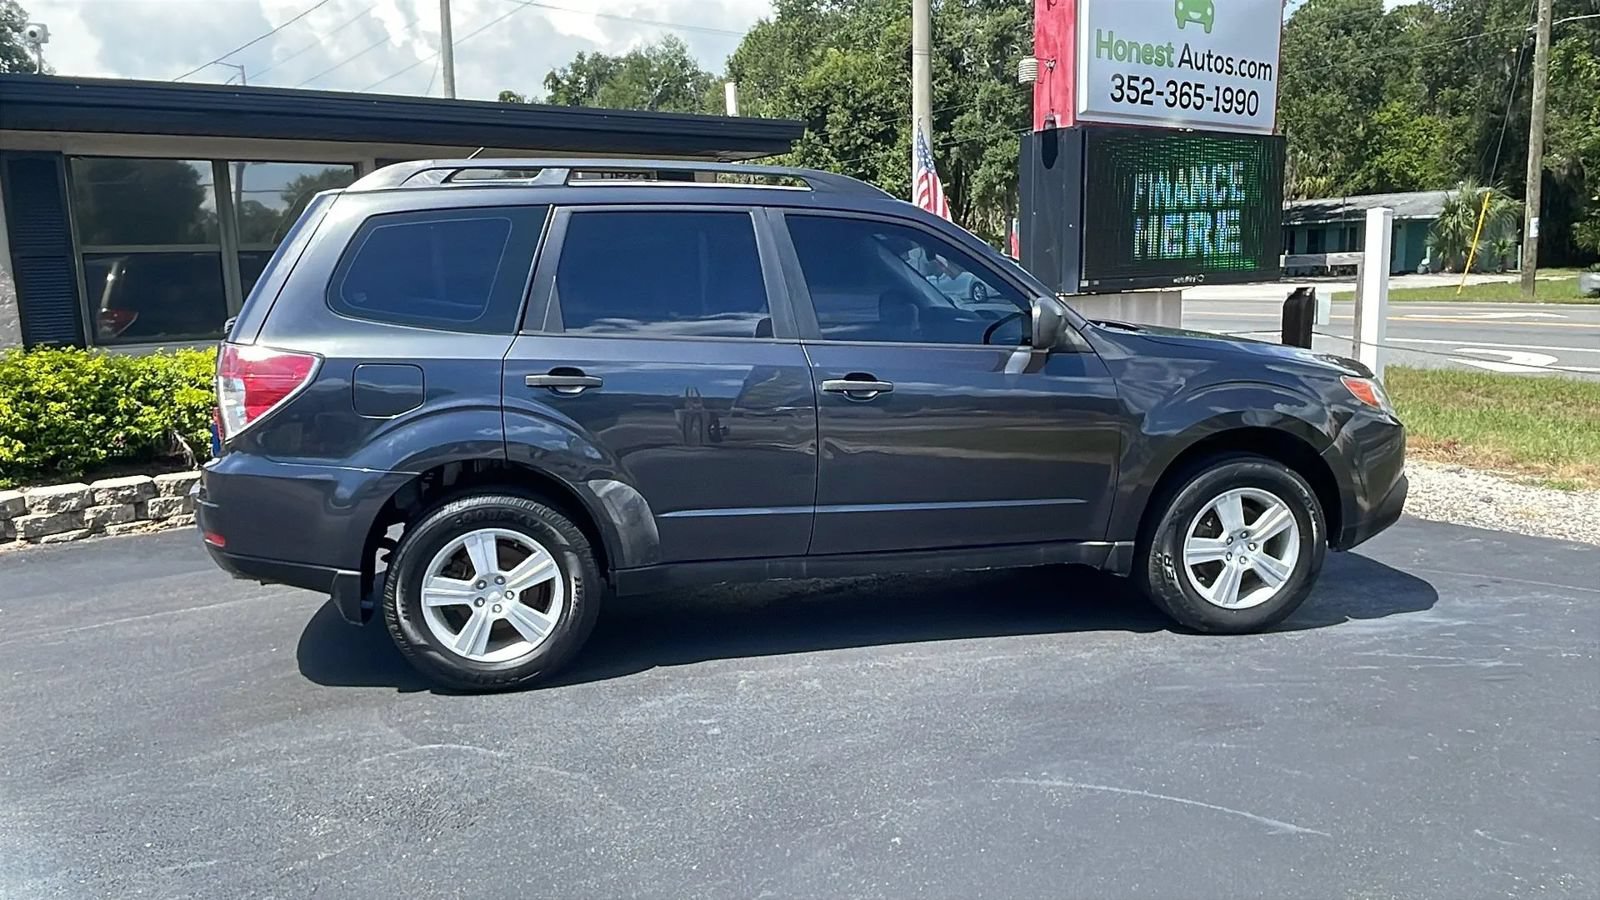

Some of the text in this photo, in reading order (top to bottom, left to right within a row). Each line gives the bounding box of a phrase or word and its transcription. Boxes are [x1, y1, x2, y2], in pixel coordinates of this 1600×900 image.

[1095, 29, 1273, 82] Honest Autos.com
[1110, 73, 1259, 116] 352-365-1990
[1133, 161, 1245, 210] FINANCE
[1133, 209, 1241, 260] HERE
